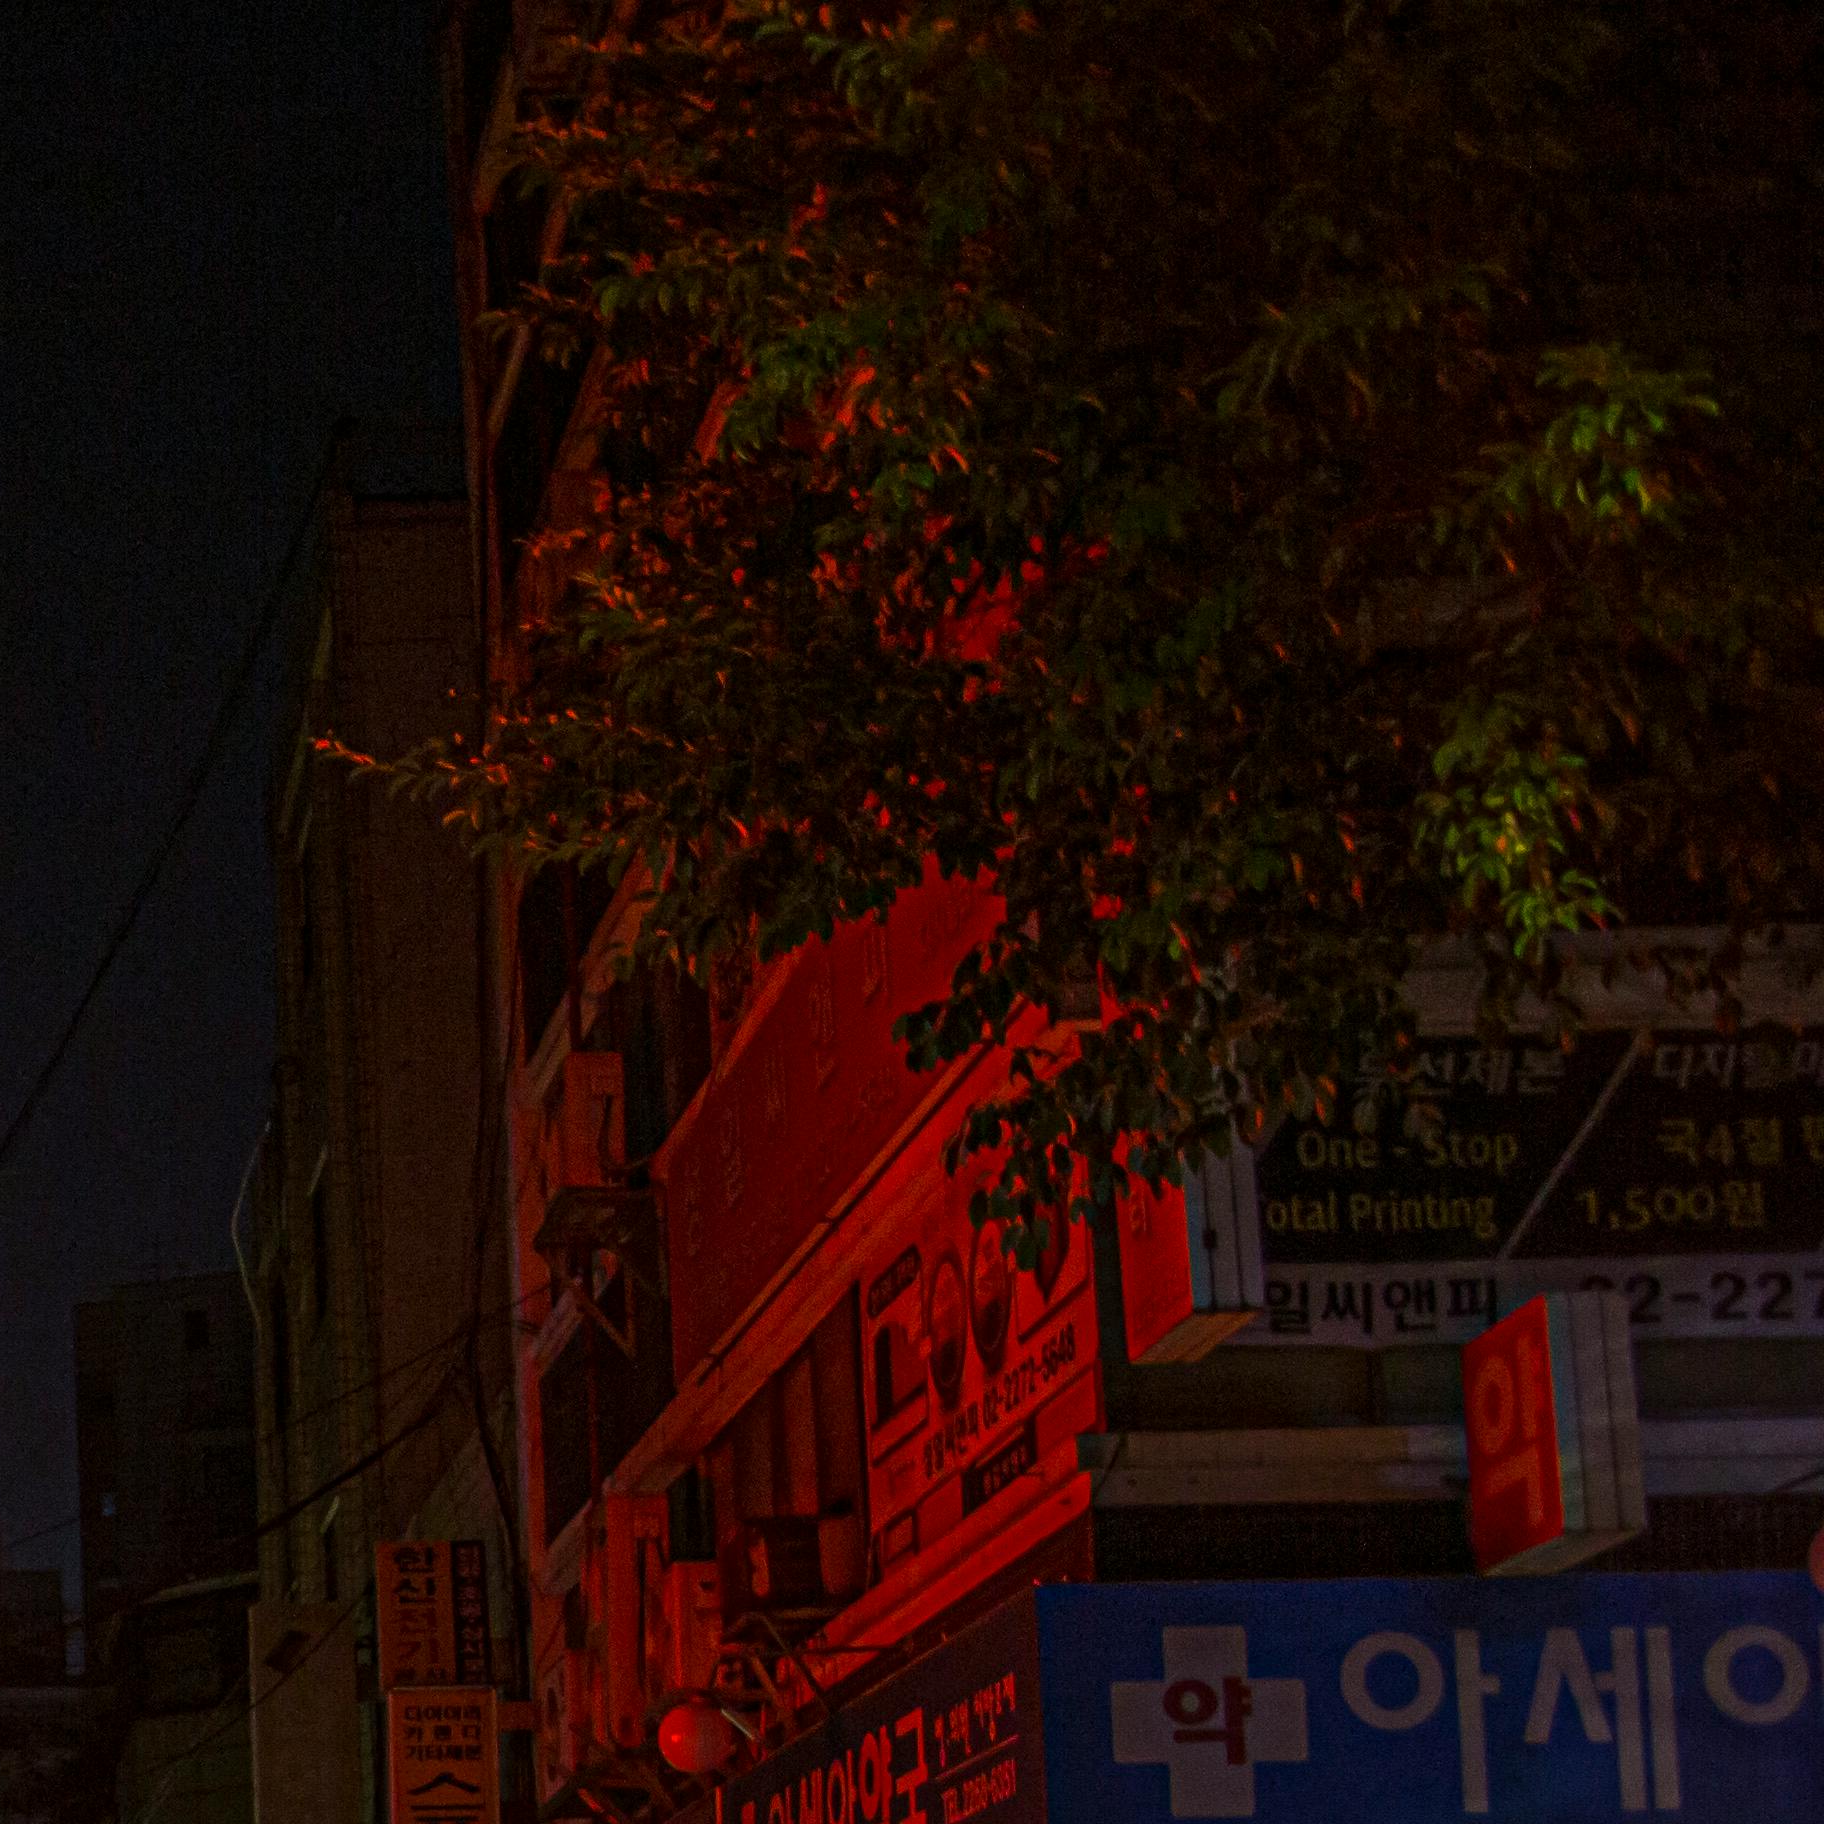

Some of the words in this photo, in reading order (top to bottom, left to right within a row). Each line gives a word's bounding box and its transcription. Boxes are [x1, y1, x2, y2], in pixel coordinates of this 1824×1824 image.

[1295, 1130, 1382, 1170] One
[1423, 1129, 1519, 1174] Stop
[1266, 1192, 1341, 1233] otal
[1354, 1191, 1500, 1240] Printing
[1471, 1333, 1545, 1529] 약
[1162, 1677, 1251, 1767] 약
